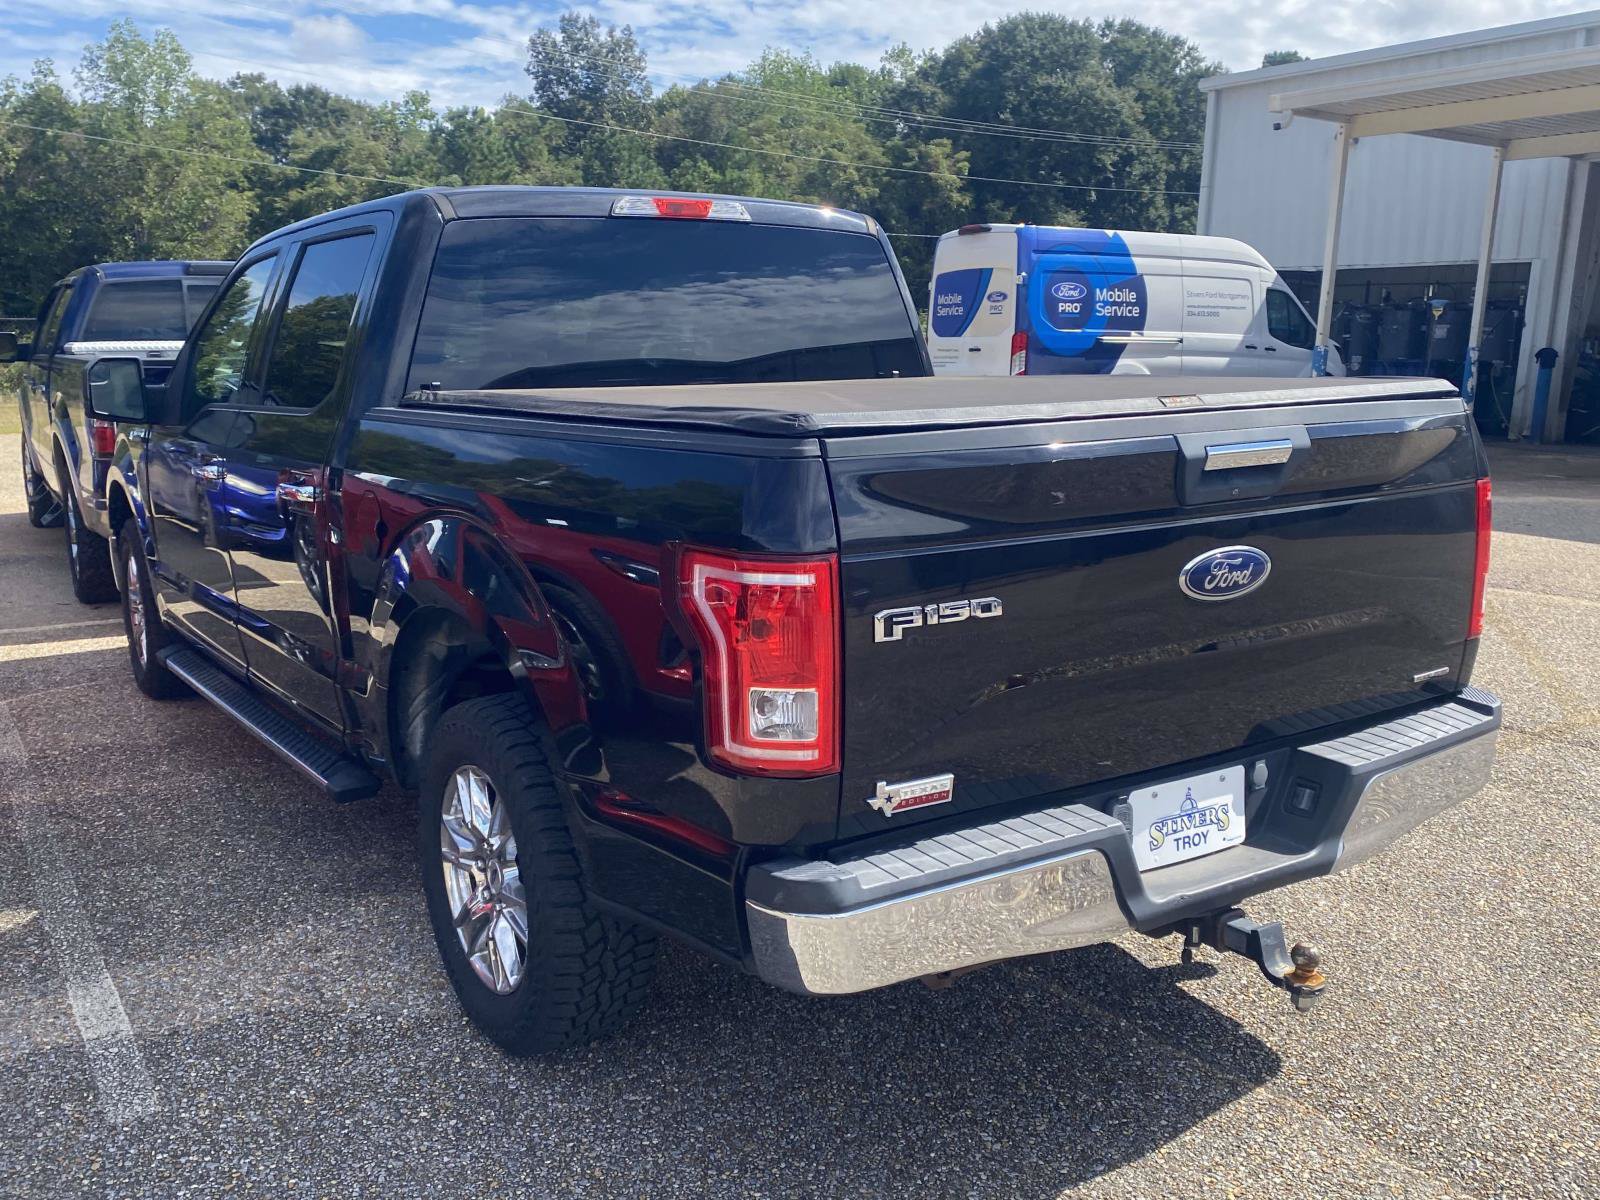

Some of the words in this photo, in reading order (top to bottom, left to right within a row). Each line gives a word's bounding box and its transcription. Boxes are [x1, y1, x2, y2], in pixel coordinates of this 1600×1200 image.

[1058, 284, 1080, 297] Ford
[1095, 287, 1137, 302] Mobile
[937, 293, 962, 305] Mobile
[937, 305, 964, 316] Service
[1058, 302, 1080, 313] PRO
[1095, 302, 1140, 317] Service
[1204, 557, 1254, 590] Ford
[900, 782, 949, 798] TEXAS
[900, 792, 948, 806] EDITION
[1149, 803, 1230, 851] STIVERS
[1173, 829, 1210, 852] TROY
